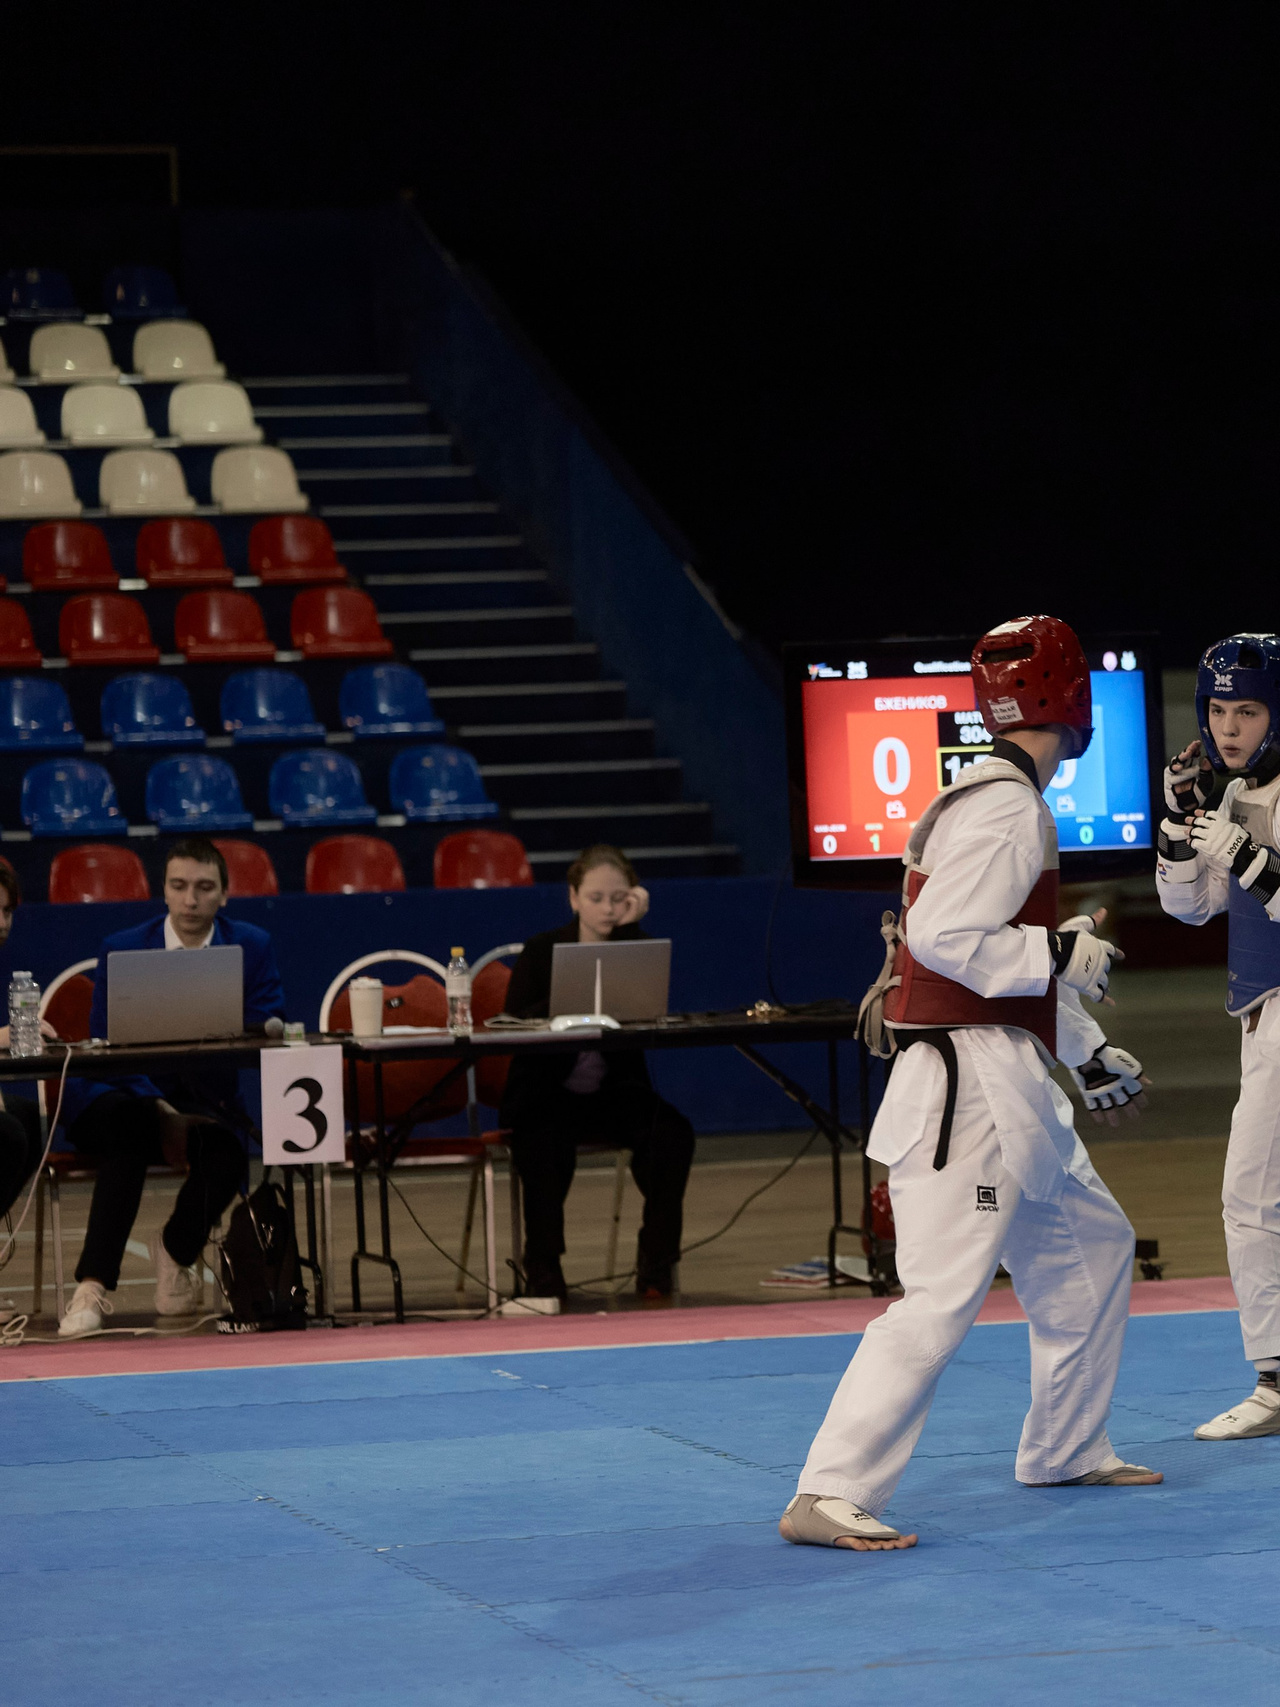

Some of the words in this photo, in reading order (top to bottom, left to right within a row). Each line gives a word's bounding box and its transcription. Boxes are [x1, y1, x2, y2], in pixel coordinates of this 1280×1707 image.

[873, 737, 911, 796] 0
[823, 835, 838, 854] 0
[869, 833, 880, 852] 1
[1080, 825, 1094, 845] 0
[1122, 823, 1137, 843] 0
[1226, 835, 1244, 857] KHAN
[282, 1077, 328, 1154] 3
[975, 1204, 1000, 1213] KWON
